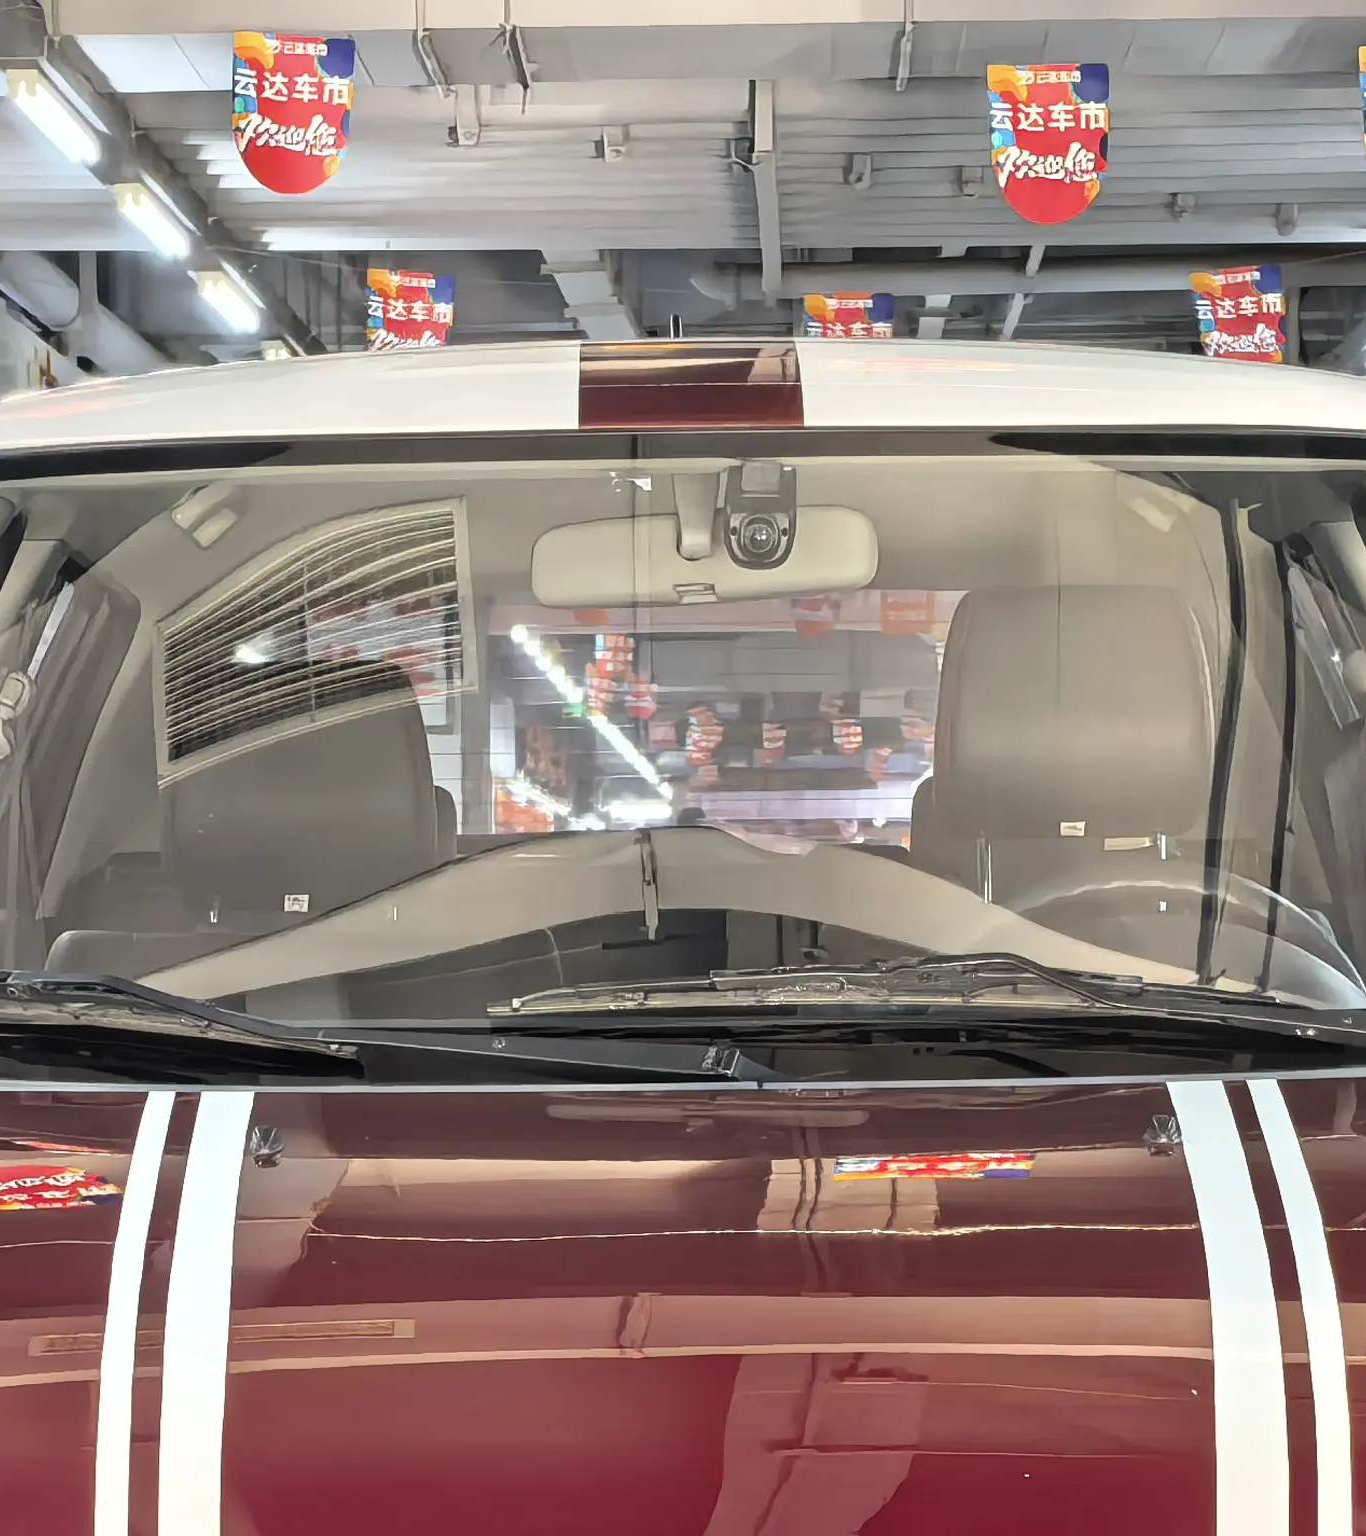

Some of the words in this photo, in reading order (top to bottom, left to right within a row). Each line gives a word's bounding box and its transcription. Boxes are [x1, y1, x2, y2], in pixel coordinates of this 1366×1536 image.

[234, 67, 351, 106] 云达车市
[237, 112, 338, 156] 欢迎您
[989, 100, 1107, 133] 云达车市
[997, 141, 1098, 189] 欢迎您
[366, 295, 454, 326] 云达车市
[1194, 292, 1283, 319] 云达车市
